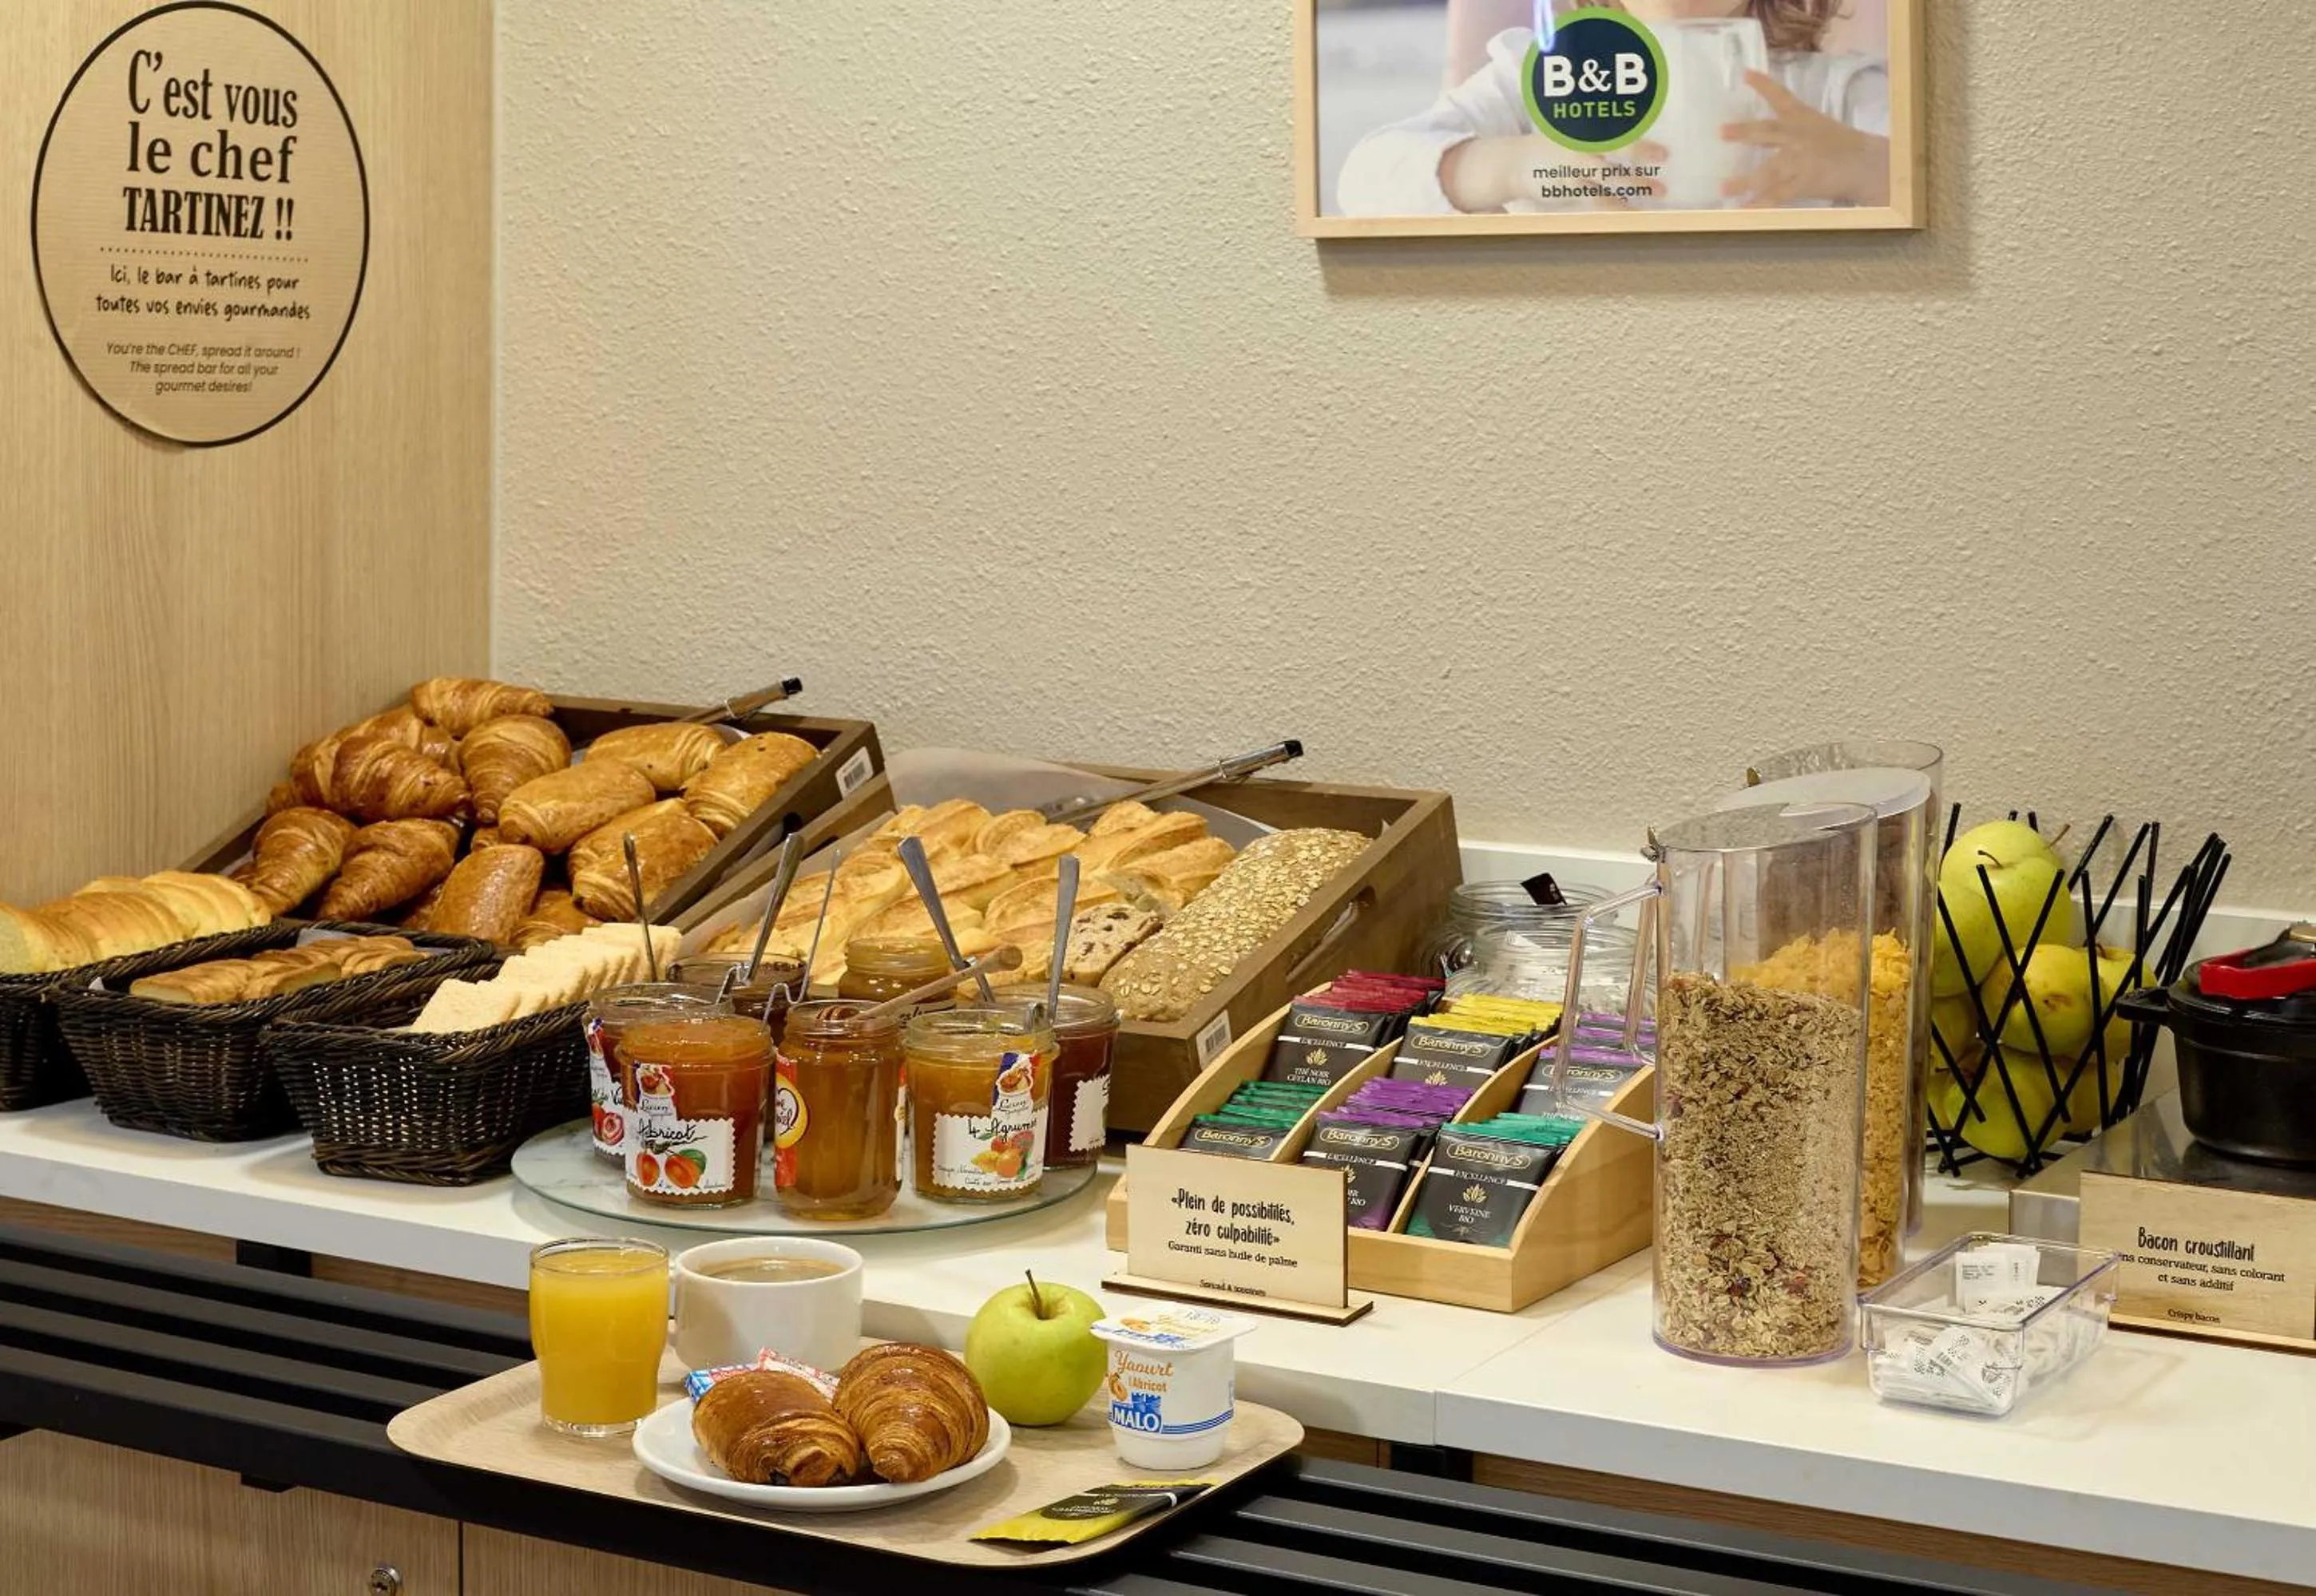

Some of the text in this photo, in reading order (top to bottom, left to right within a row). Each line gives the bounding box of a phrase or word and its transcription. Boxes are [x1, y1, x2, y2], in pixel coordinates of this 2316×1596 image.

[1543, 53, 1648, 97] B&B
[128, 49, 299, 128] C'est vous
[1553, 101, 1636, 119] HOTELS
[126, 121, 298, 184] le chef
[1533, 164, 1661, 181] meilleur prix sur
[1541, 184, 1653, 199] bbhotels.com
[122, 187, 295, 240] TARTINEZ !!
[110, 264, 300, 295] Ici, le bar à tartines pour
[95, 293, 311, 321] toutes vos envies gourmandes
[106, 342, 144, 356] You're
[145, 343, 165, 356] the
[168, 343, 199, 358] CHEF,
[201, 344, 243, 359] spread
[243, 345, 252, 357] it
[253, 345, 295, 358] around
[129, 361, 279, 379] The spread bar for all your
[154, 380, 253, 396] gourmet desires!
[1300, 1037, 1346, 1047] EXCELLENCE
[1311, 1069, 1331, 1078] NOIR
[1417, 1059, 1467, 1071] EXCELLENCE
[637, 1118, 698, 1140] Abricot
[1327, 1152, 1377, 1165] EXCELLENCE
[1455, 1170, 1508, 1185] EXCELLENCE
[1212, 1196, 1226, 1214] de
[1449, 1203, 1492, 1218] VERVEINE
[1185, 1218, 1211, 1238] zéro
[1458, 1214, 1475, 1224] BIO
[2138, 1226, 2255, 1262] Bacon croustillant
[1168, 1240, 1298, 1268] Garanti sans huile de palme
[2138, 1254, 2209, 1274] conservateur,
[2211, 1263, 2237, 1277] sans
[2239, 1268, 2286, 1283] colorant
[2157, 1273, 2235, 1292] et sans additif
[2167, 1308, 2220, 1323] Crispy bacon
[1114, 1349, 1175, 1377] Yaourt
[1113, 1406, 1161, 1432] MALO
